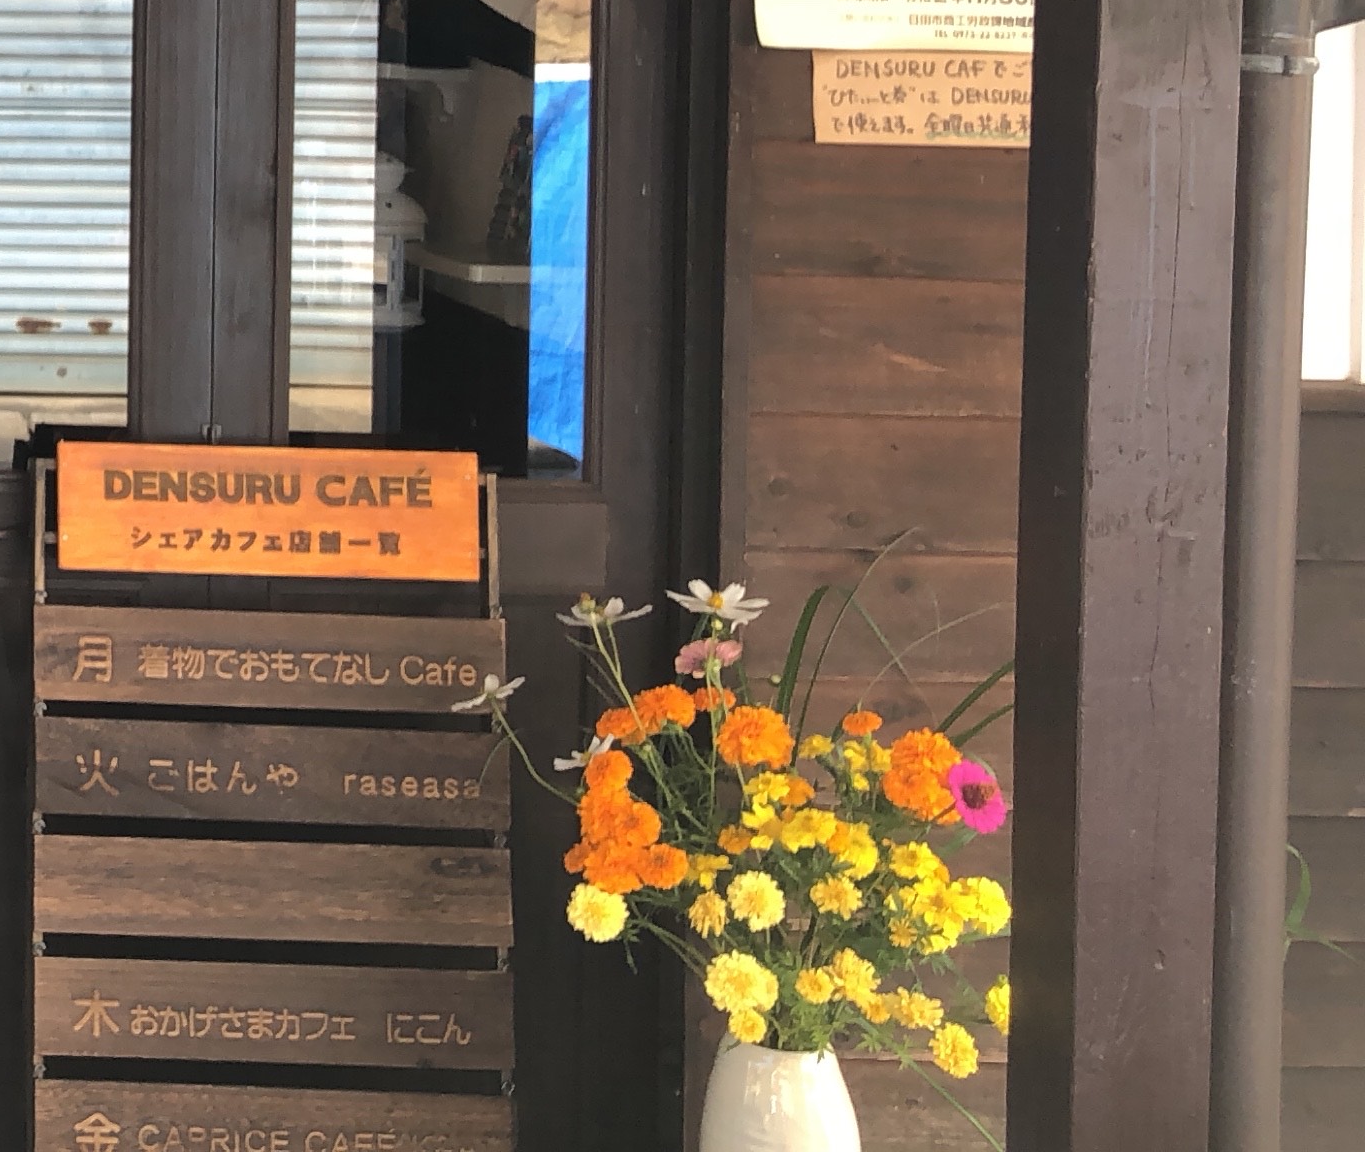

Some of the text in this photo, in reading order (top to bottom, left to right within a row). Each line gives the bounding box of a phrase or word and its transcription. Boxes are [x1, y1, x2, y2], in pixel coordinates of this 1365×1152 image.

[836, 59, 936, 79] DENSURU
[103, 467, 433, 508] DENSURU CAFÉ
[131, 525, 402, 556] シェアカフェ店舗一覧
[72, 634, 478, 687] 月 着物でおもてなし Cafe
[75, 748, 482, 800] 火 ごはんや raseasa
[72, 989, 472, 1046] 木 おかげさまカフェ にこん
[73, 1112, 121, 1152] 金
